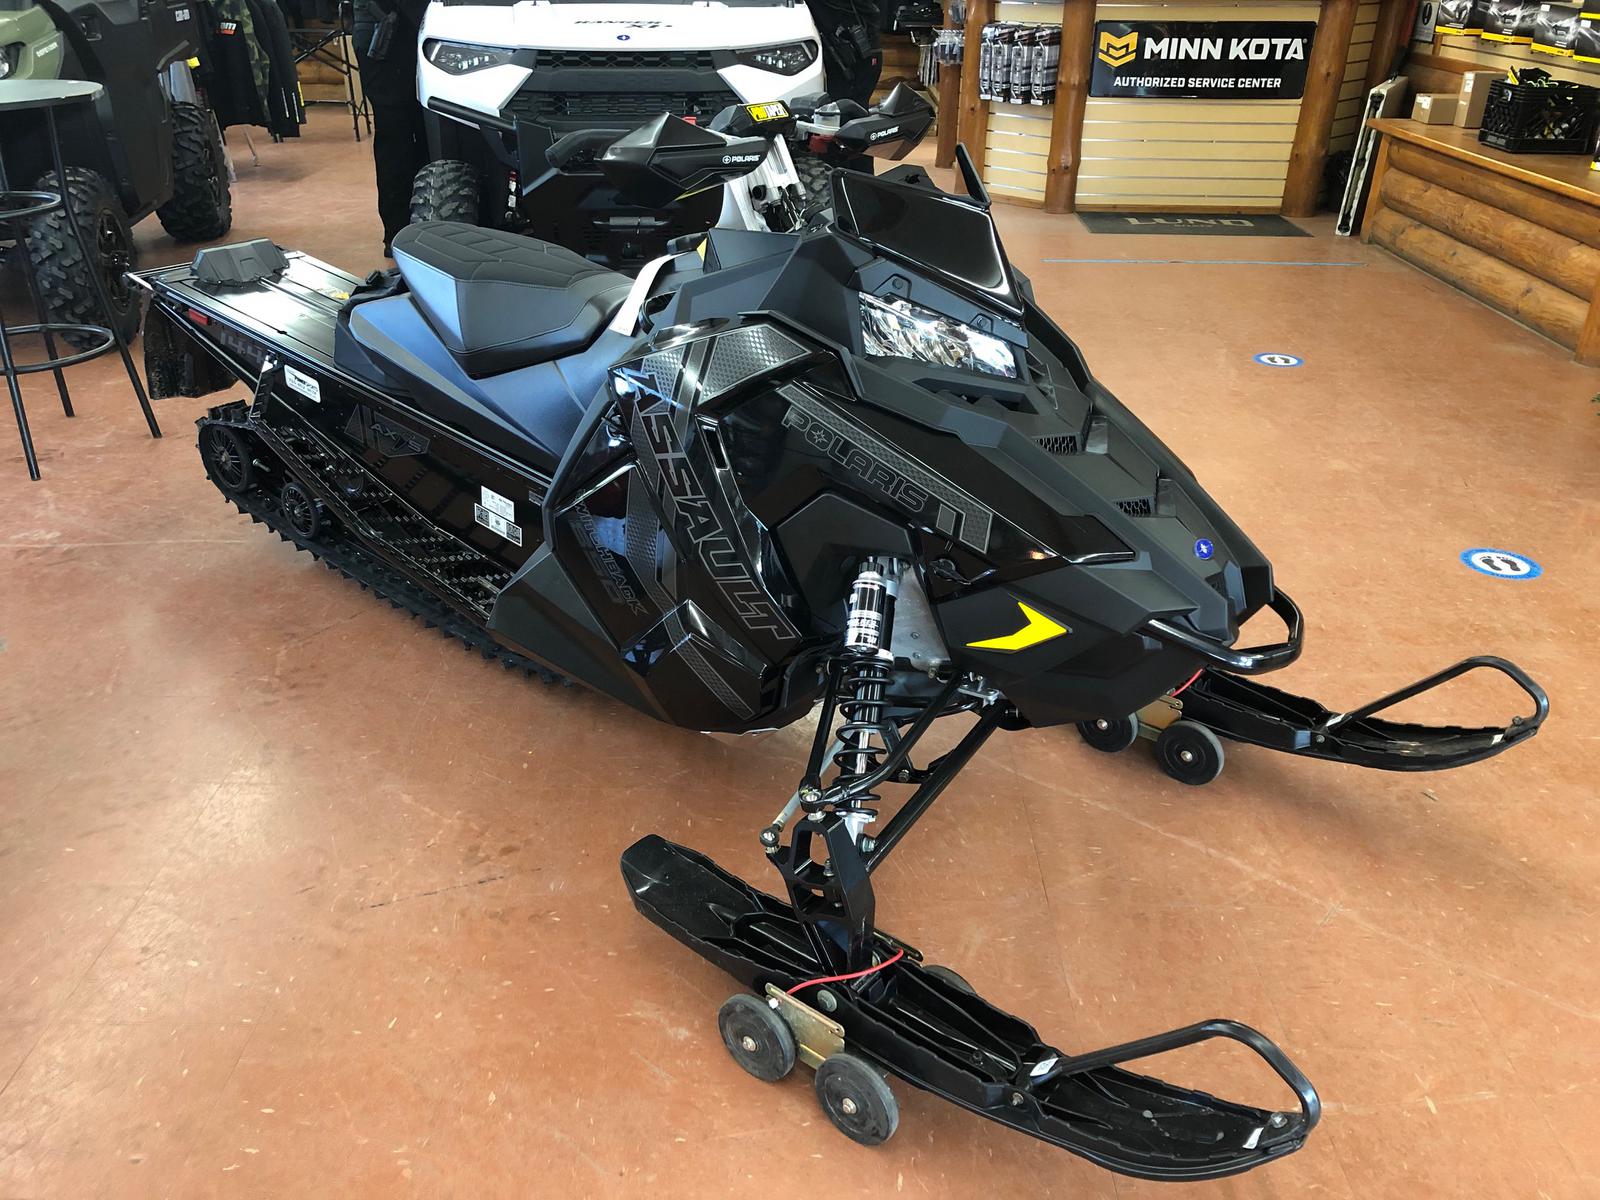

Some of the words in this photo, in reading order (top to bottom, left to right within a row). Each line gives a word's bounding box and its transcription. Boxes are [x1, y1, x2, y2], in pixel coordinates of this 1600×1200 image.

[1143, 37, 1223, 60] MINN
[1228, 37, 1305, 60] KOTA
[1113, 76, 1185, 88] AUTHORIZED
[1187, 77, 1235, 88] SERVICE
[1238, 78, 1282, 88] CENTER
[877, 126, 900, 139] POLARIS
[732, 155, 760, 163] POLARIS
[1123, 217, 1255, 227] LUND
[781, 404, 929, 513] POLARIS
[622, 369, 796, 641] ASSAULT
